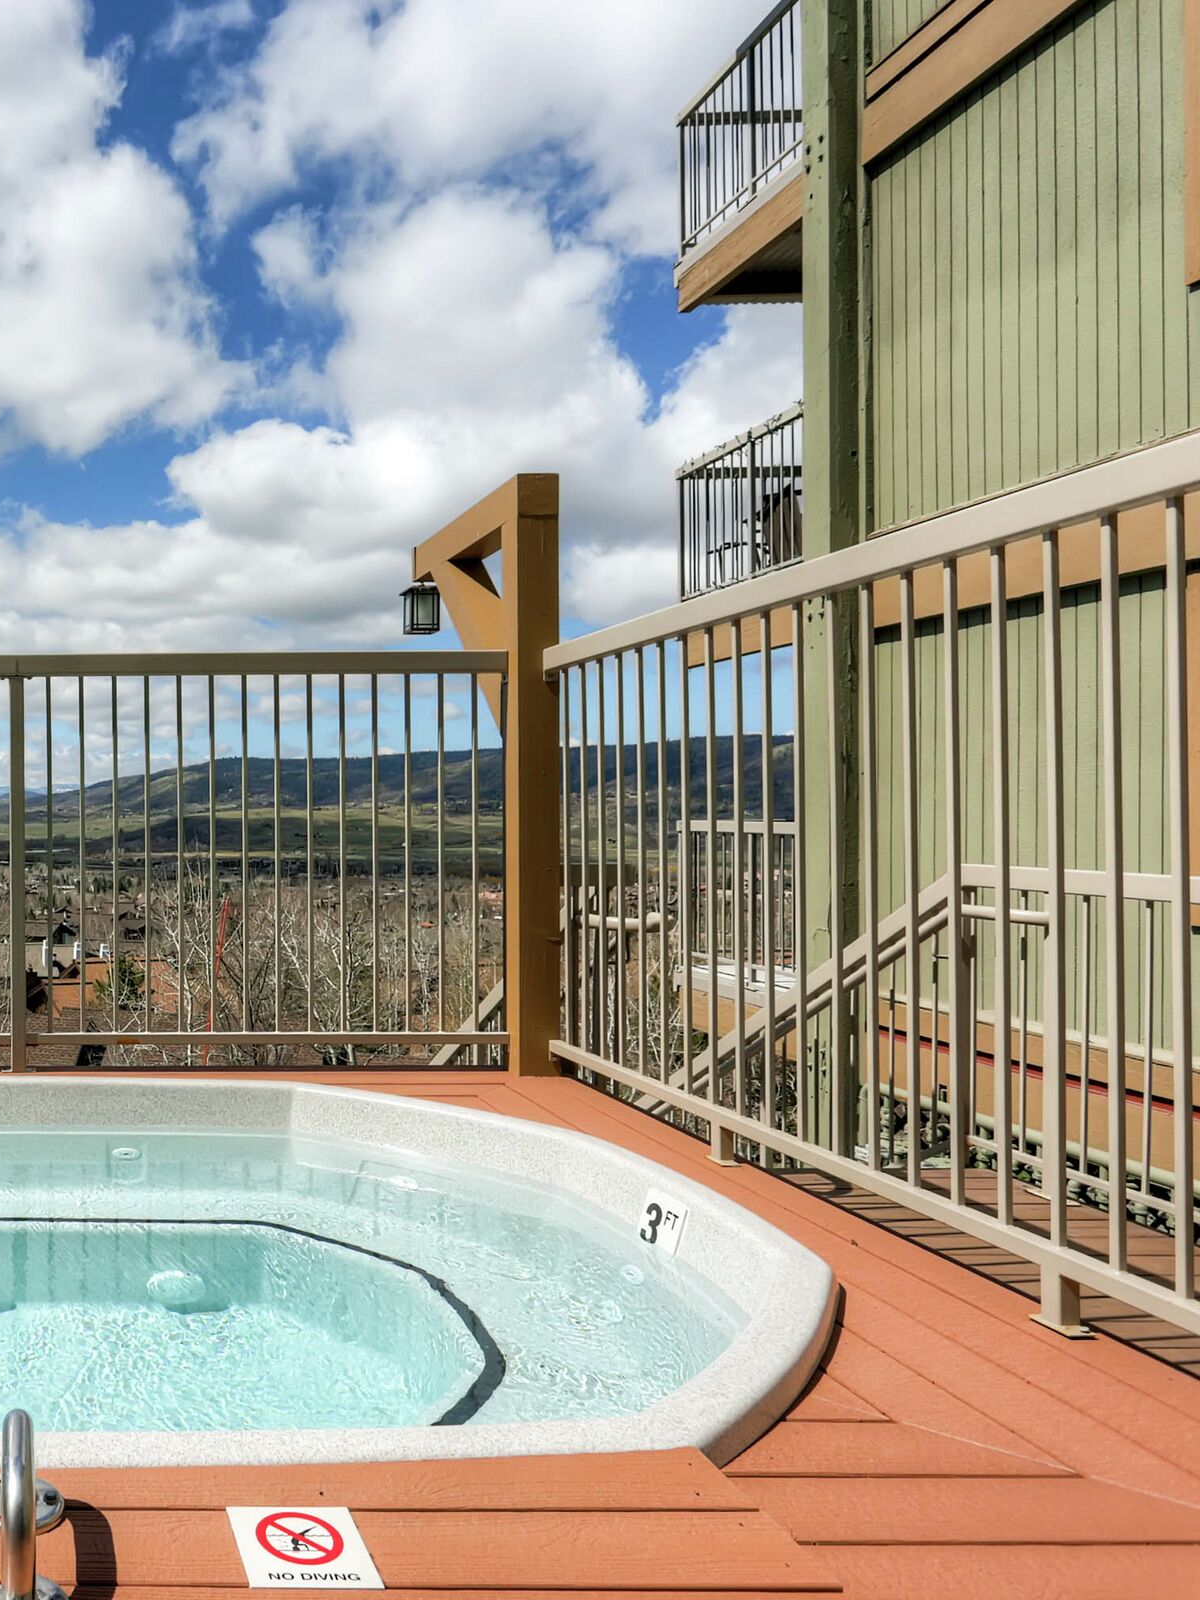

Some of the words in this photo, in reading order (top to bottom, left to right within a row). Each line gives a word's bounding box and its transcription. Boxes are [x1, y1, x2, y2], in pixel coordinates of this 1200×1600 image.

[640, 1203, 663, 1244] 3
[663, 1210, 679, 1230] FT
[268, 1572, 295, 1581] NO
[300, 1572, 361, 1582] DIVING
